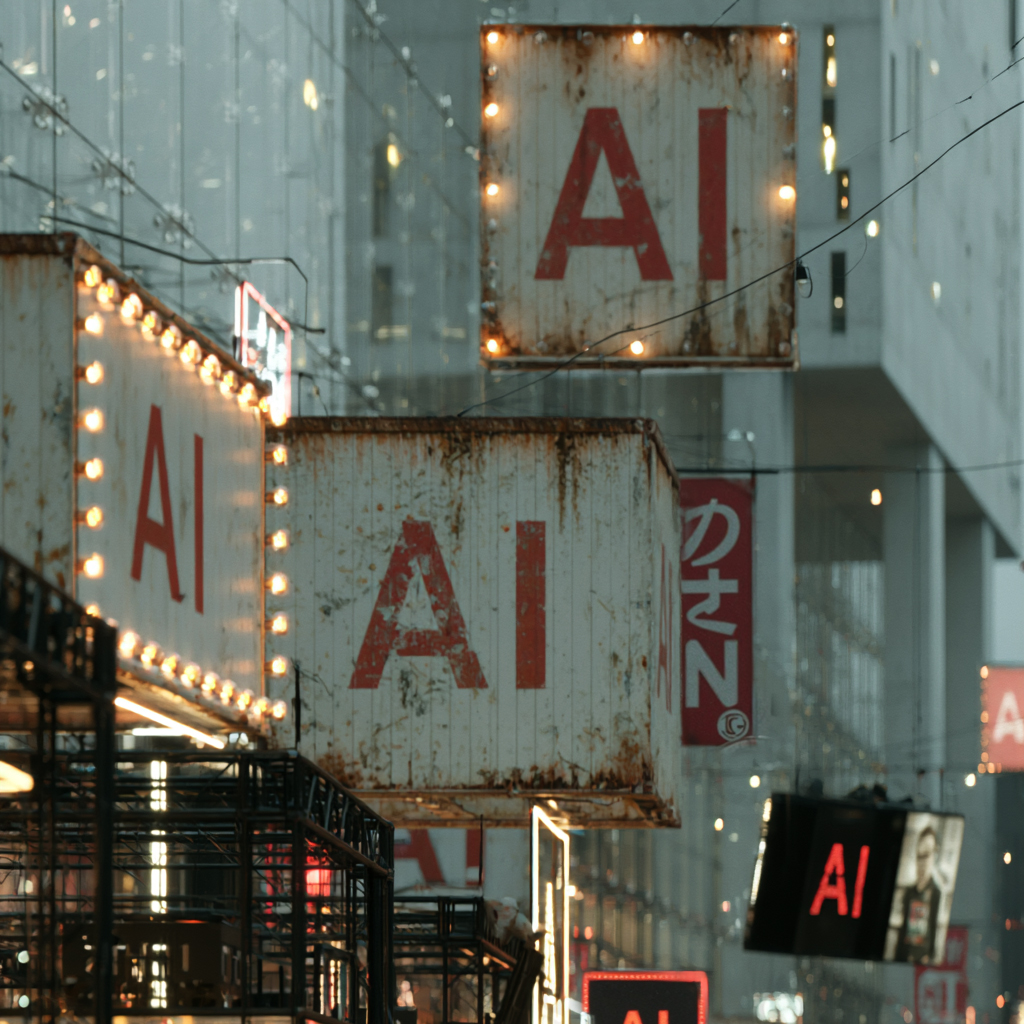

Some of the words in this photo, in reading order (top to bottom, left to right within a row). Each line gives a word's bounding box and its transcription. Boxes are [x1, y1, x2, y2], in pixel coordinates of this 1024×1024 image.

[534, 107, 728, 281] AI
[131, 403, 204, 615] AI
[349, 520, 546, 689] AI
[809, 843, 870, 919] AI
